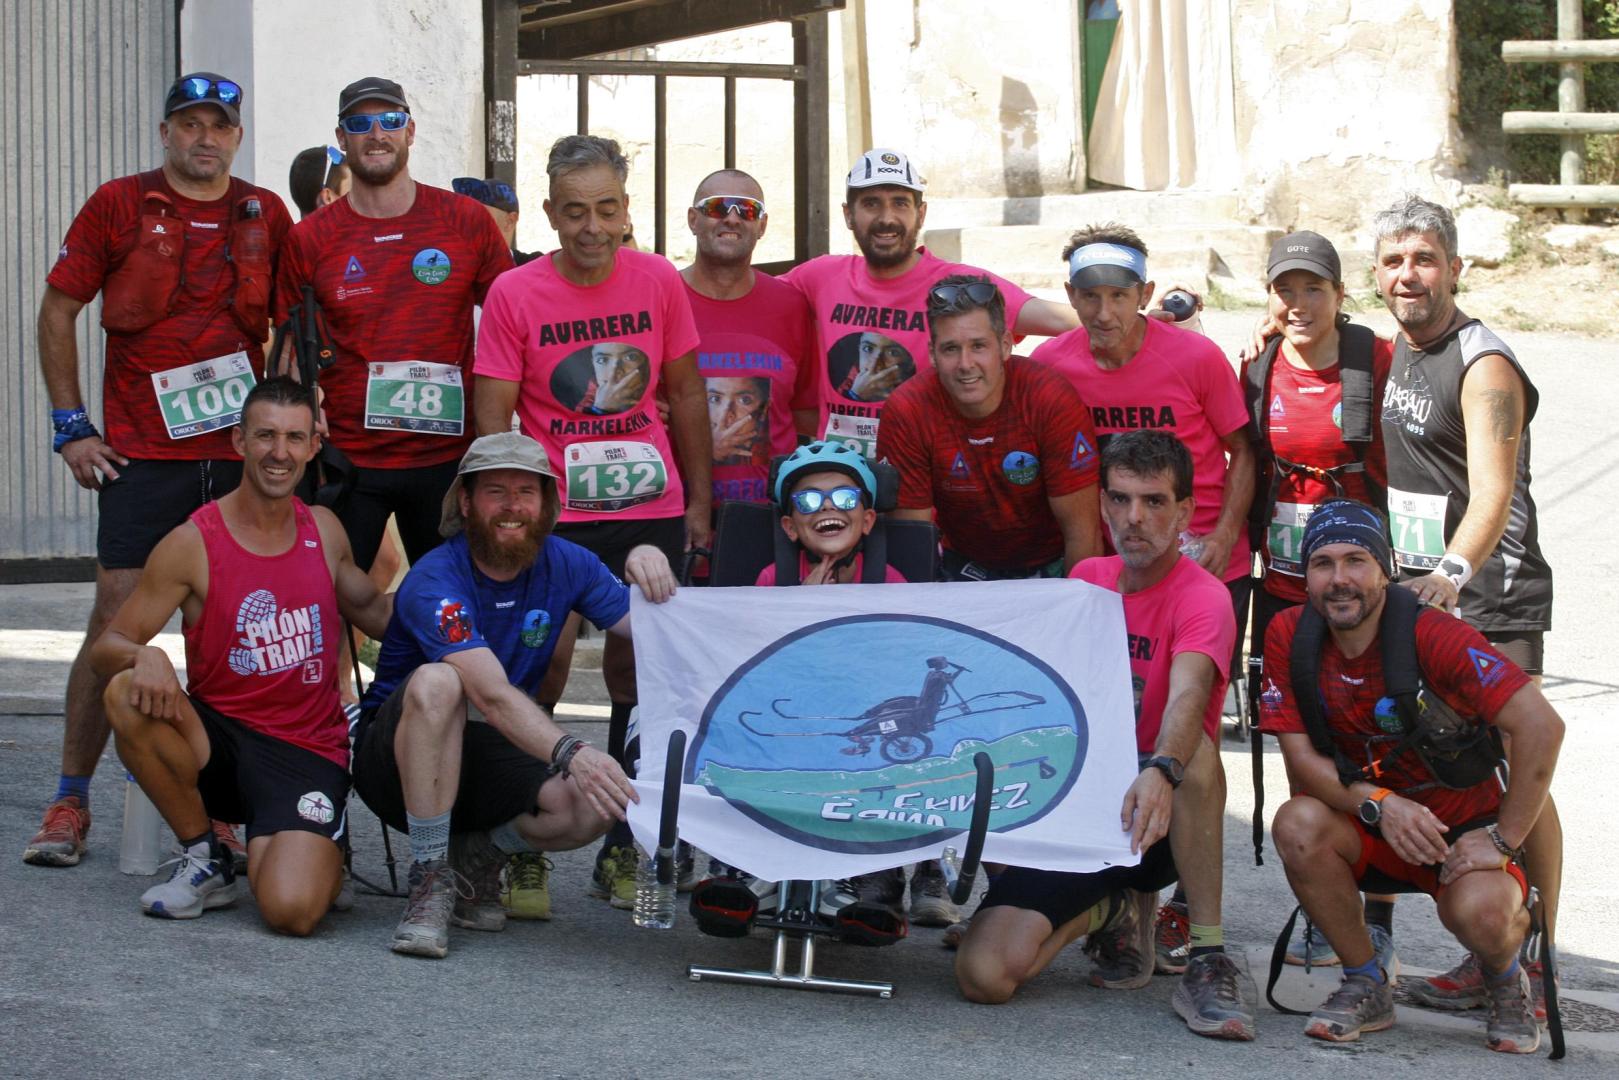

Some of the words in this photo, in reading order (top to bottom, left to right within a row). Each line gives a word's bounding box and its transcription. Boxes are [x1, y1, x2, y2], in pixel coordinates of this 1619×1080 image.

[1287, 245, 1310, 254] GORE
[539, 310, 653, 347] AURRERA
[830, 303, 926, 333] AURRERA
[171, 377, 249, 421] 100
[389, 382, 443, 416] 48
[1089, 405, 1177, 428] RRERA
[549, 410, 653, 436] MARKELEKIN
[578, 462, 657, 498] 132
[1277, 526, 1303, 558] 1
[1396, 515, 1425, 552] 71
[245, 607, 312, 649] PILÓN
[251, 633, 313, 673] TRAIL
